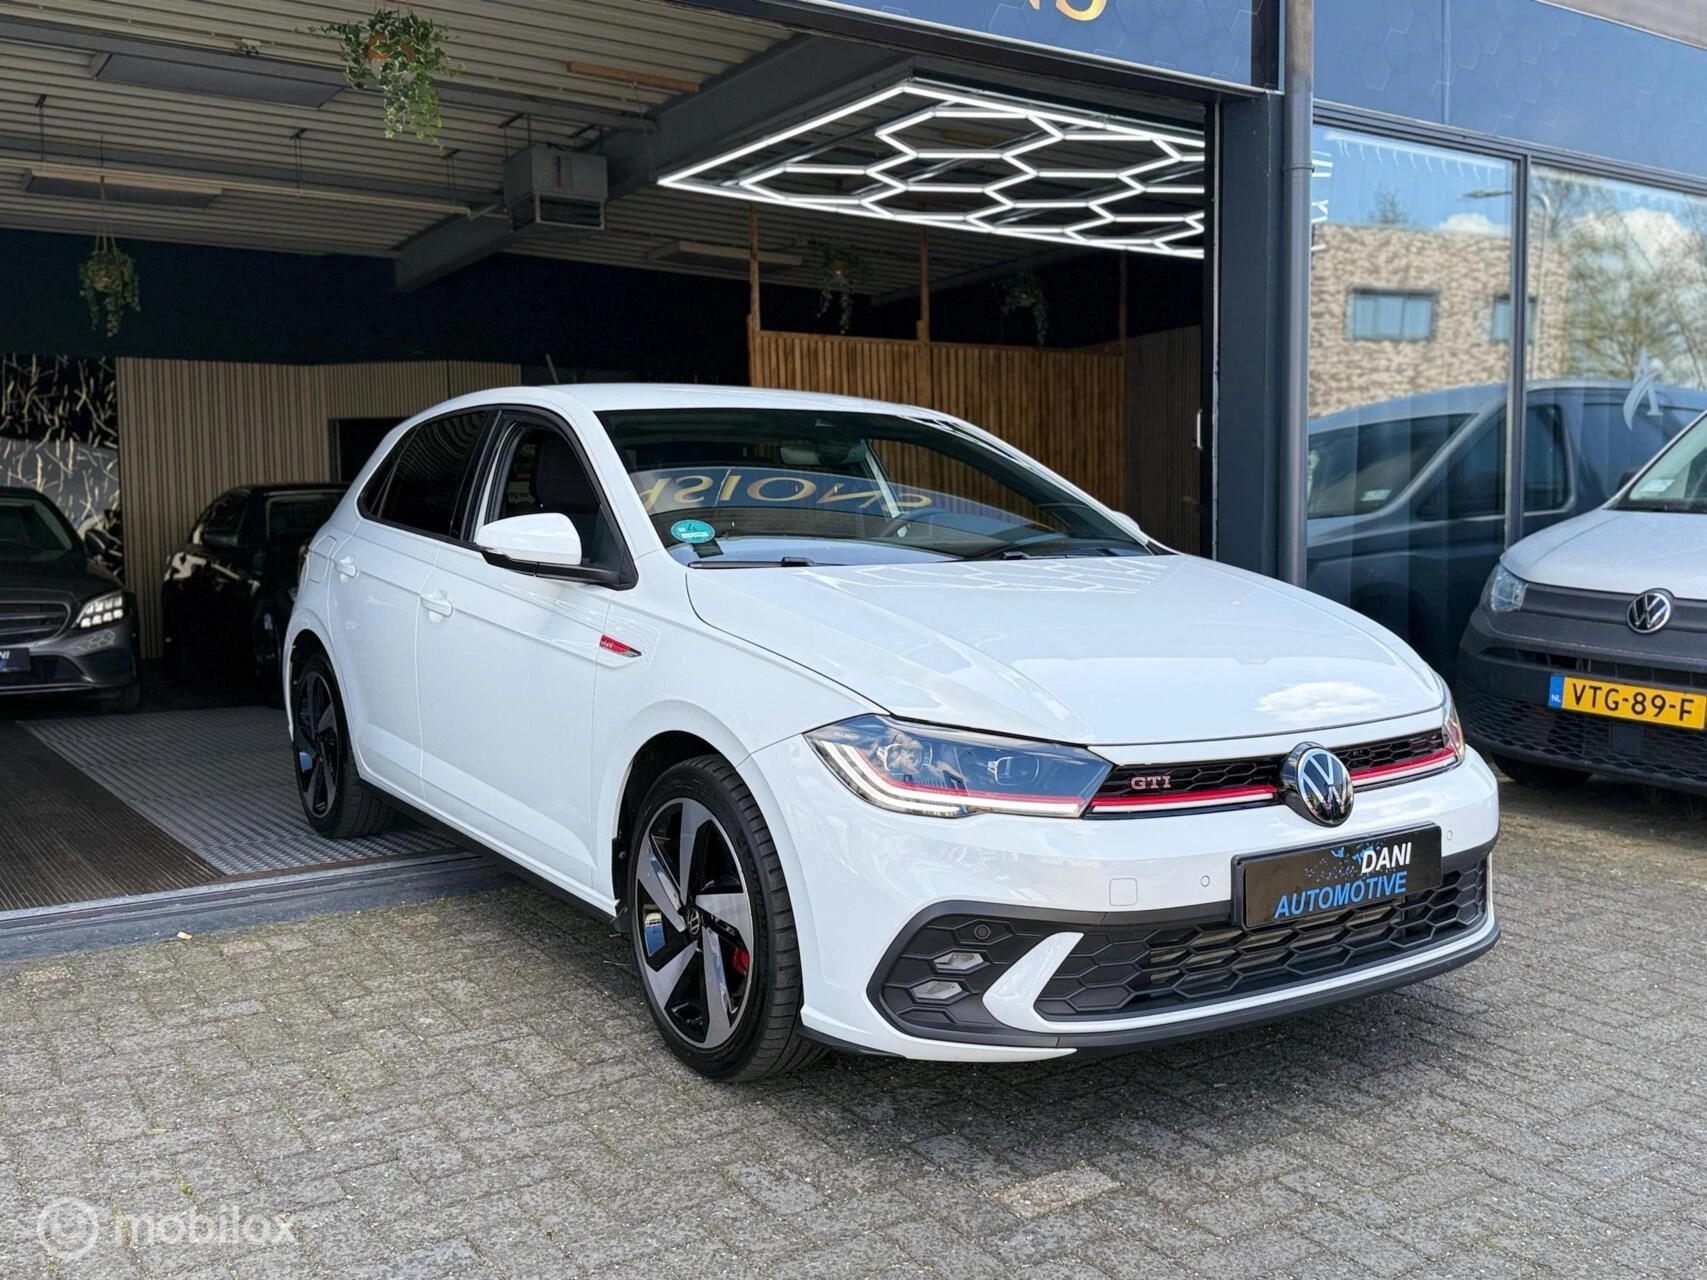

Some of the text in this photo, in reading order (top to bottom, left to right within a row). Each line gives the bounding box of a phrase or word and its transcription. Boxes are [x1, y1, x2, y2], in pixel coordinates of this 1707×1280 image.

[1572, 683, 1694, 721] VTG-89-F
[1131, 775, 1171, 790] GTI
[1360, 842, 1412, 875] DANI
[1274, 871, 1407, 919] AUTOMOTIVE
